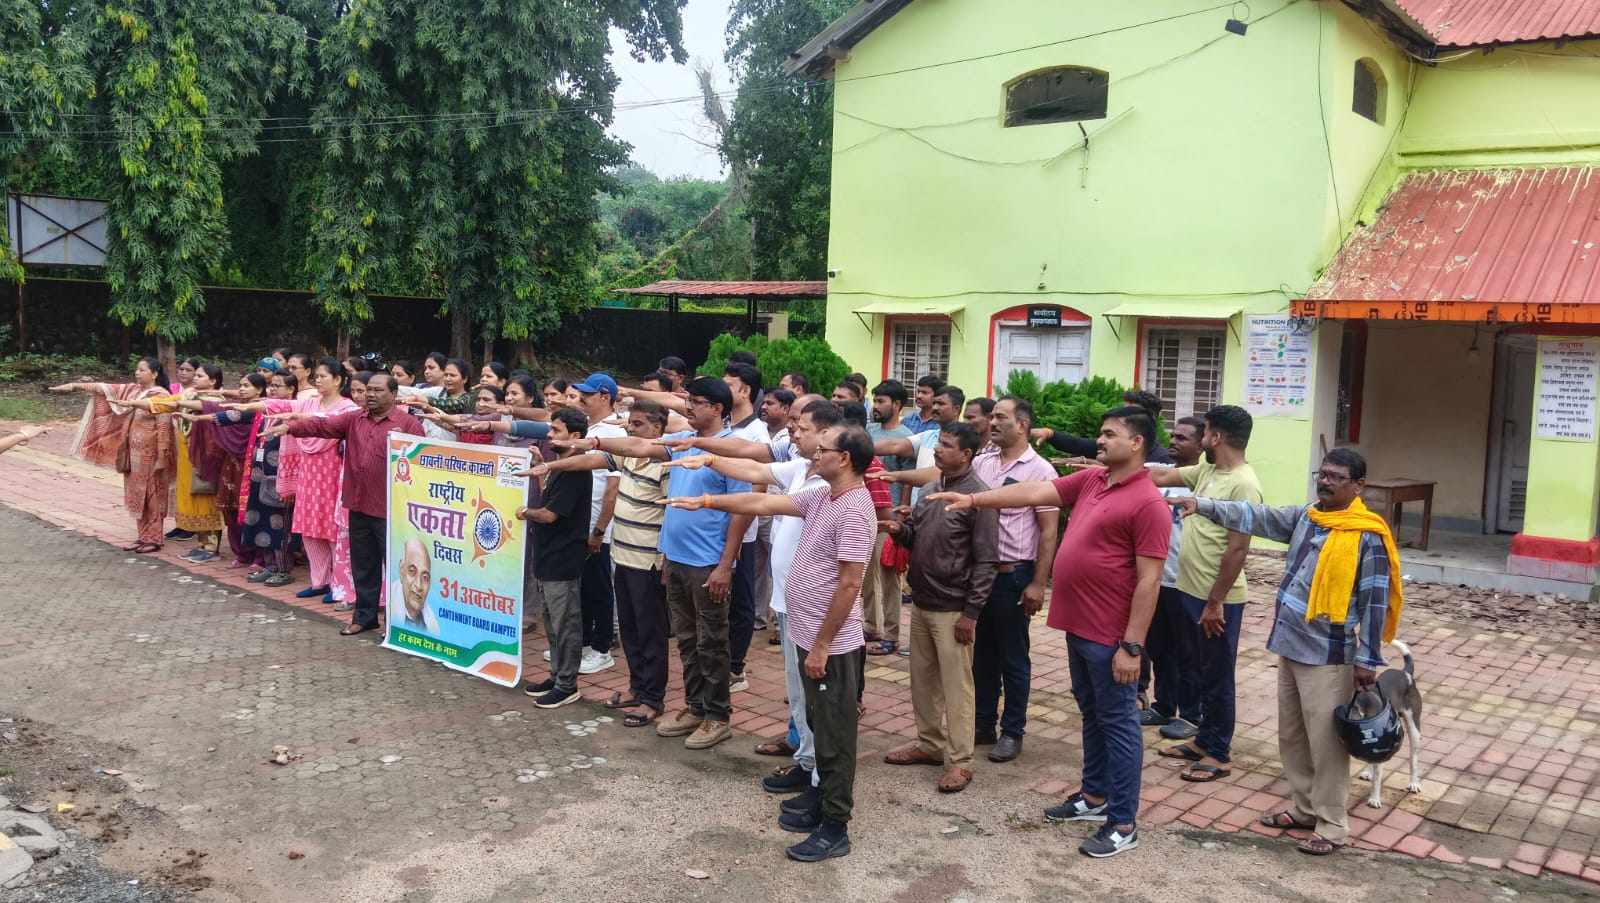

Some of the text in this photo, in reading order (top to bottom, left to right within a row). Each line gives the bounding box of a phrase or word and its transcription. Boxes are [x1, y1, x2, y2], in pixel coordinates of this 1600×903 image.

[419, 454, 443, 469] छावनी
[468, 461, 494, 476] कामठी
[428, 480, 466, 505] राष्ट्रीय
[407, 502, 468, 540] एकता
[433, 540, 463, 565] दिवस
[438, 607, 516, 638] CANTONMENT BOARD KAMPTEE
[398, 632, 458, 658] हर काम देश के नाम
